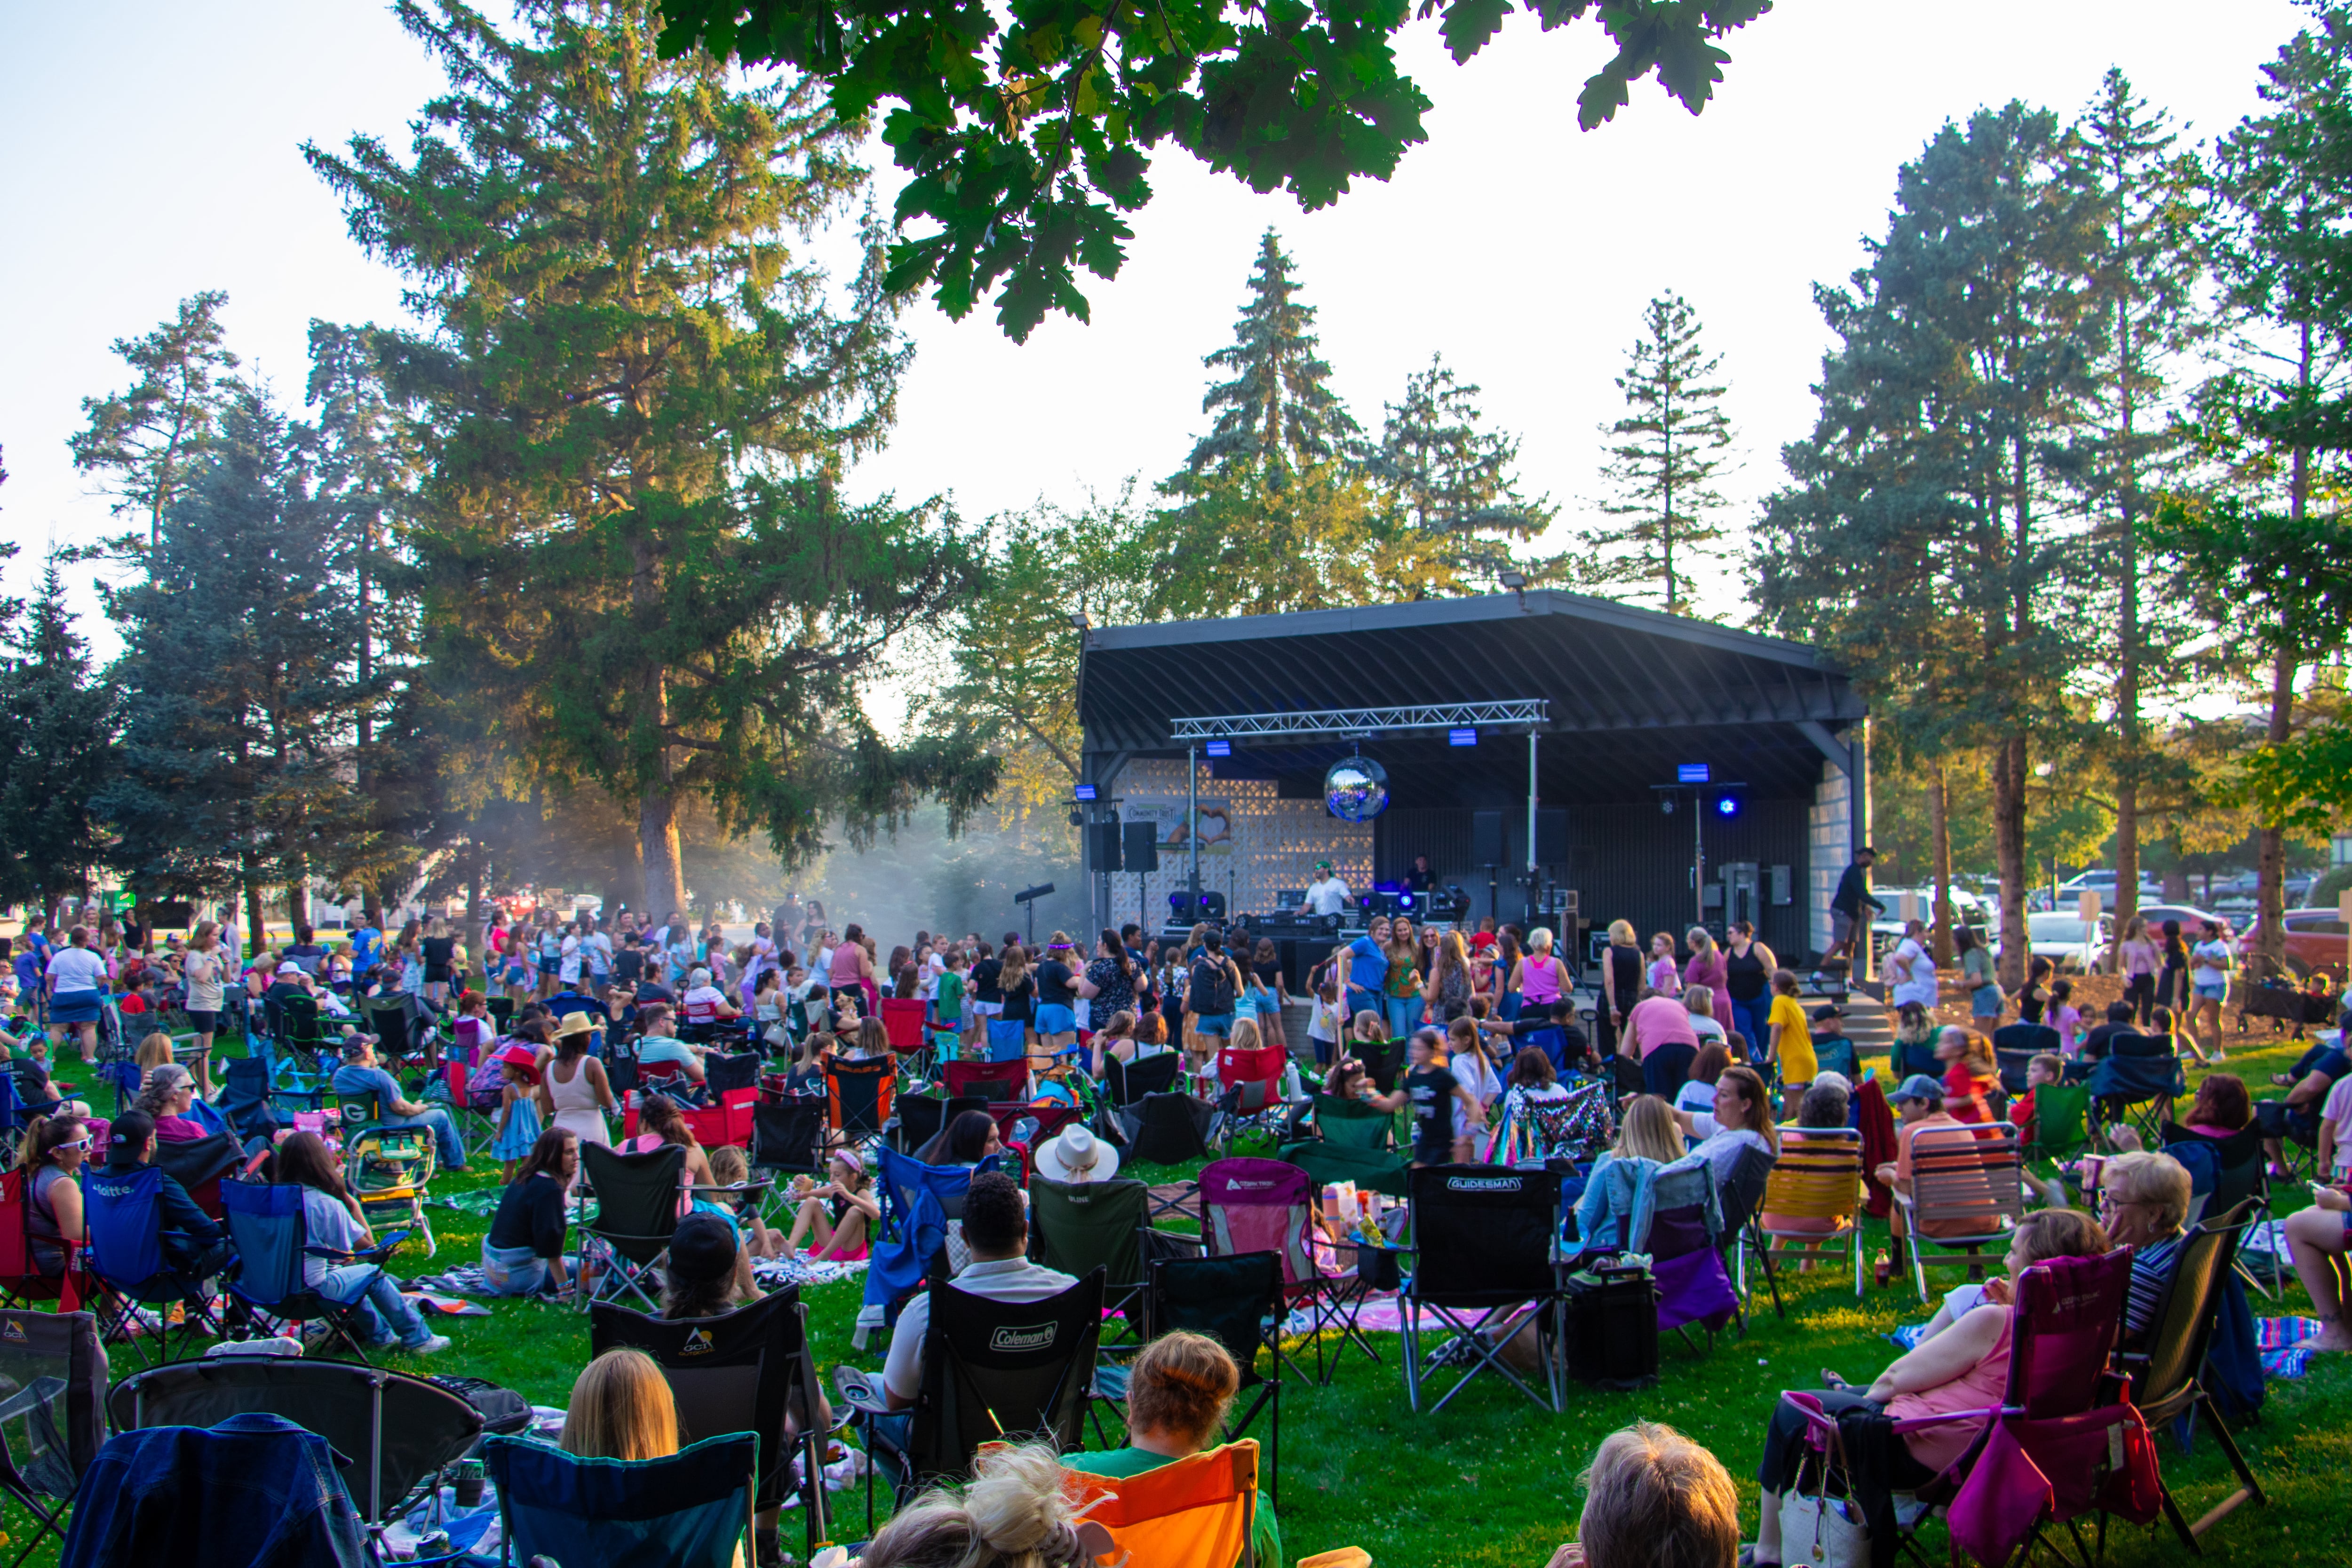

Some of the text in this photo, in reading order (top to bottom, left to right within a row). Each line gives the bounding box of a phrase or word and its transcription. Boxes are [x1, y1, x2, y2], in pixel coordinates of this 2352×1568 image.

[1451, 1179, 1517, 1189] GUIDESMAN
[997, 1330, 1044, 1345] Coleman
[684, 1343, 707, 1351] GCI
